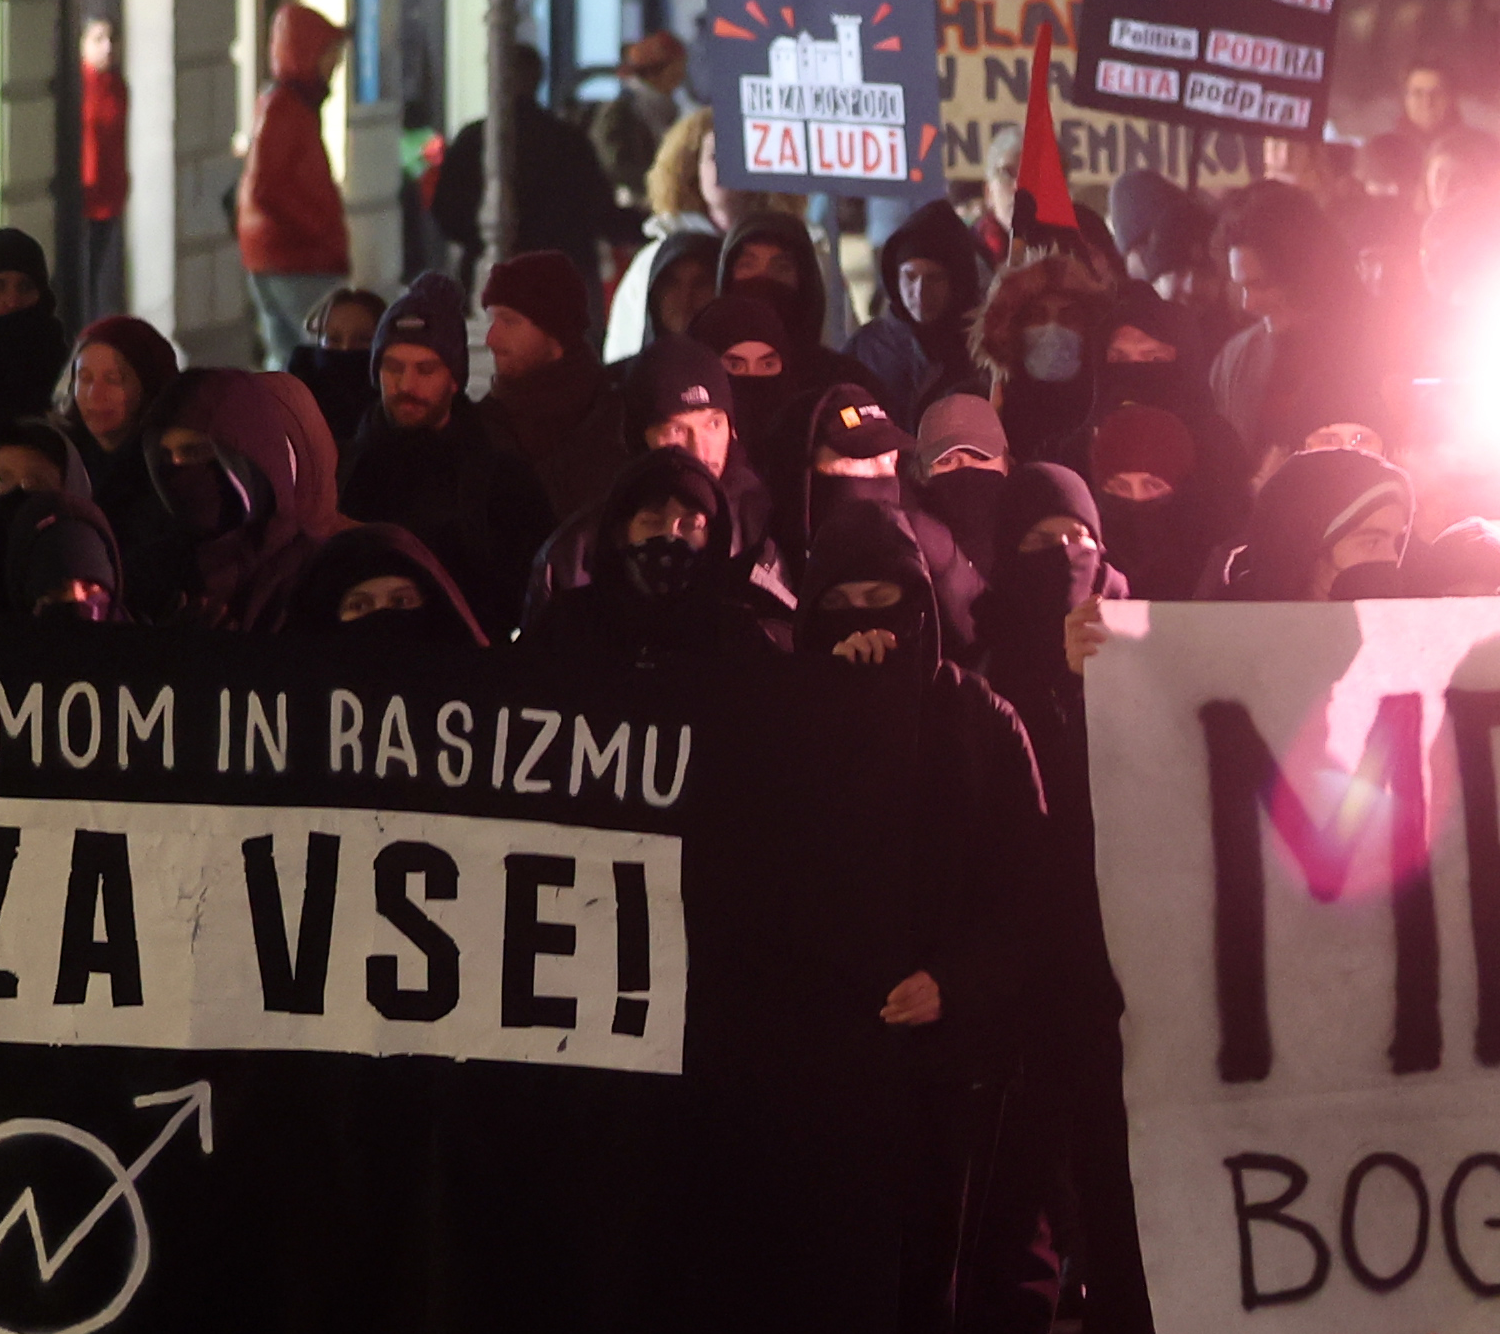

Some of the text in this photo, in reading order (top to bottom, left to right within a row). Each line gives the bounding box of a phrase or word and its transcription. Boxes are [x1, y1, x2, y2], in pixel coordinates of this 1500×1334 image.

[1102, 62, 1174, 98] ELITA
[752, 123, 801, 168] ZA
[215, 688, 289, 774] IN
[329, 688, 693, 807] RASIZMU
[239, 830, 653, 1039] VSE!
